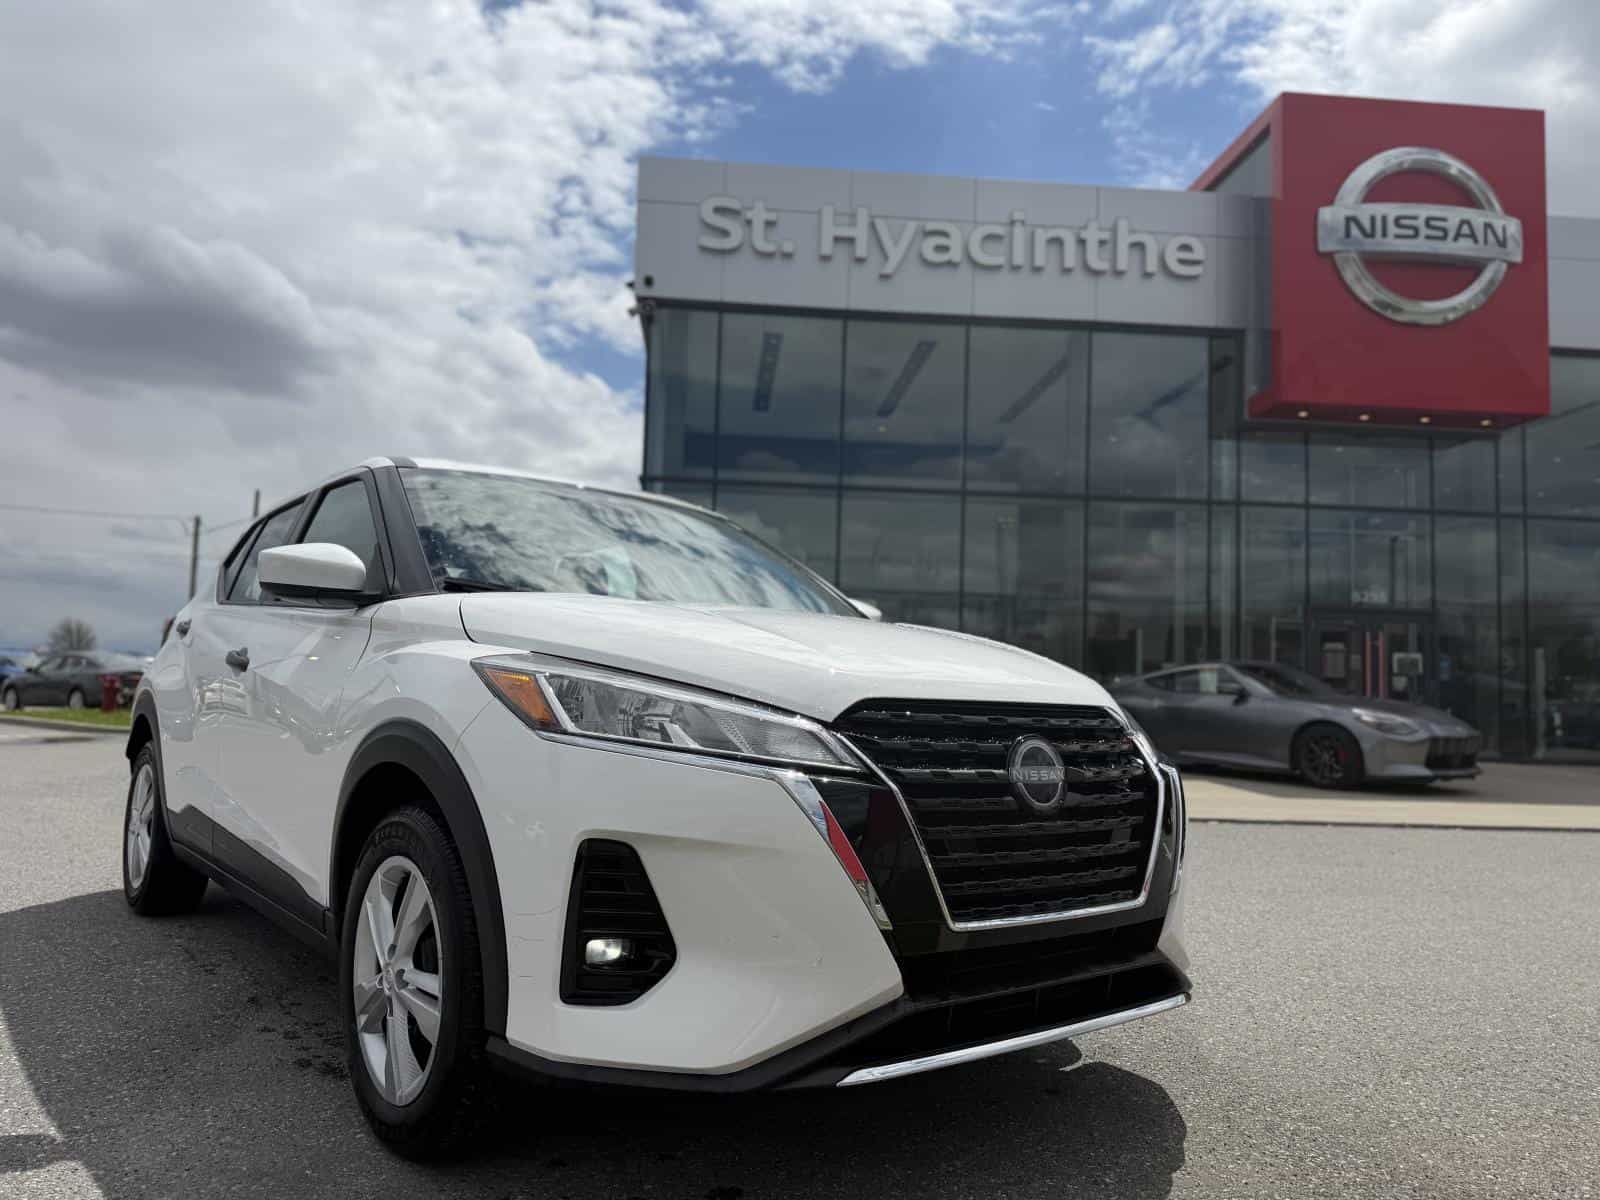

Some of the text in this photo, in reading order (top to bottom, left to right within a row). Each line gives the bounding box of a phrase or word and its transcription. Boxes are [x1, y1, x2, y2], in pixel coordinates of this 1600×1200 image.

[699, 196, 1206, 281] St. Hyacinthe
[1344, 213, 1508, 249] NISSAN
[1012, 769, 1065, 781] NISSAN
